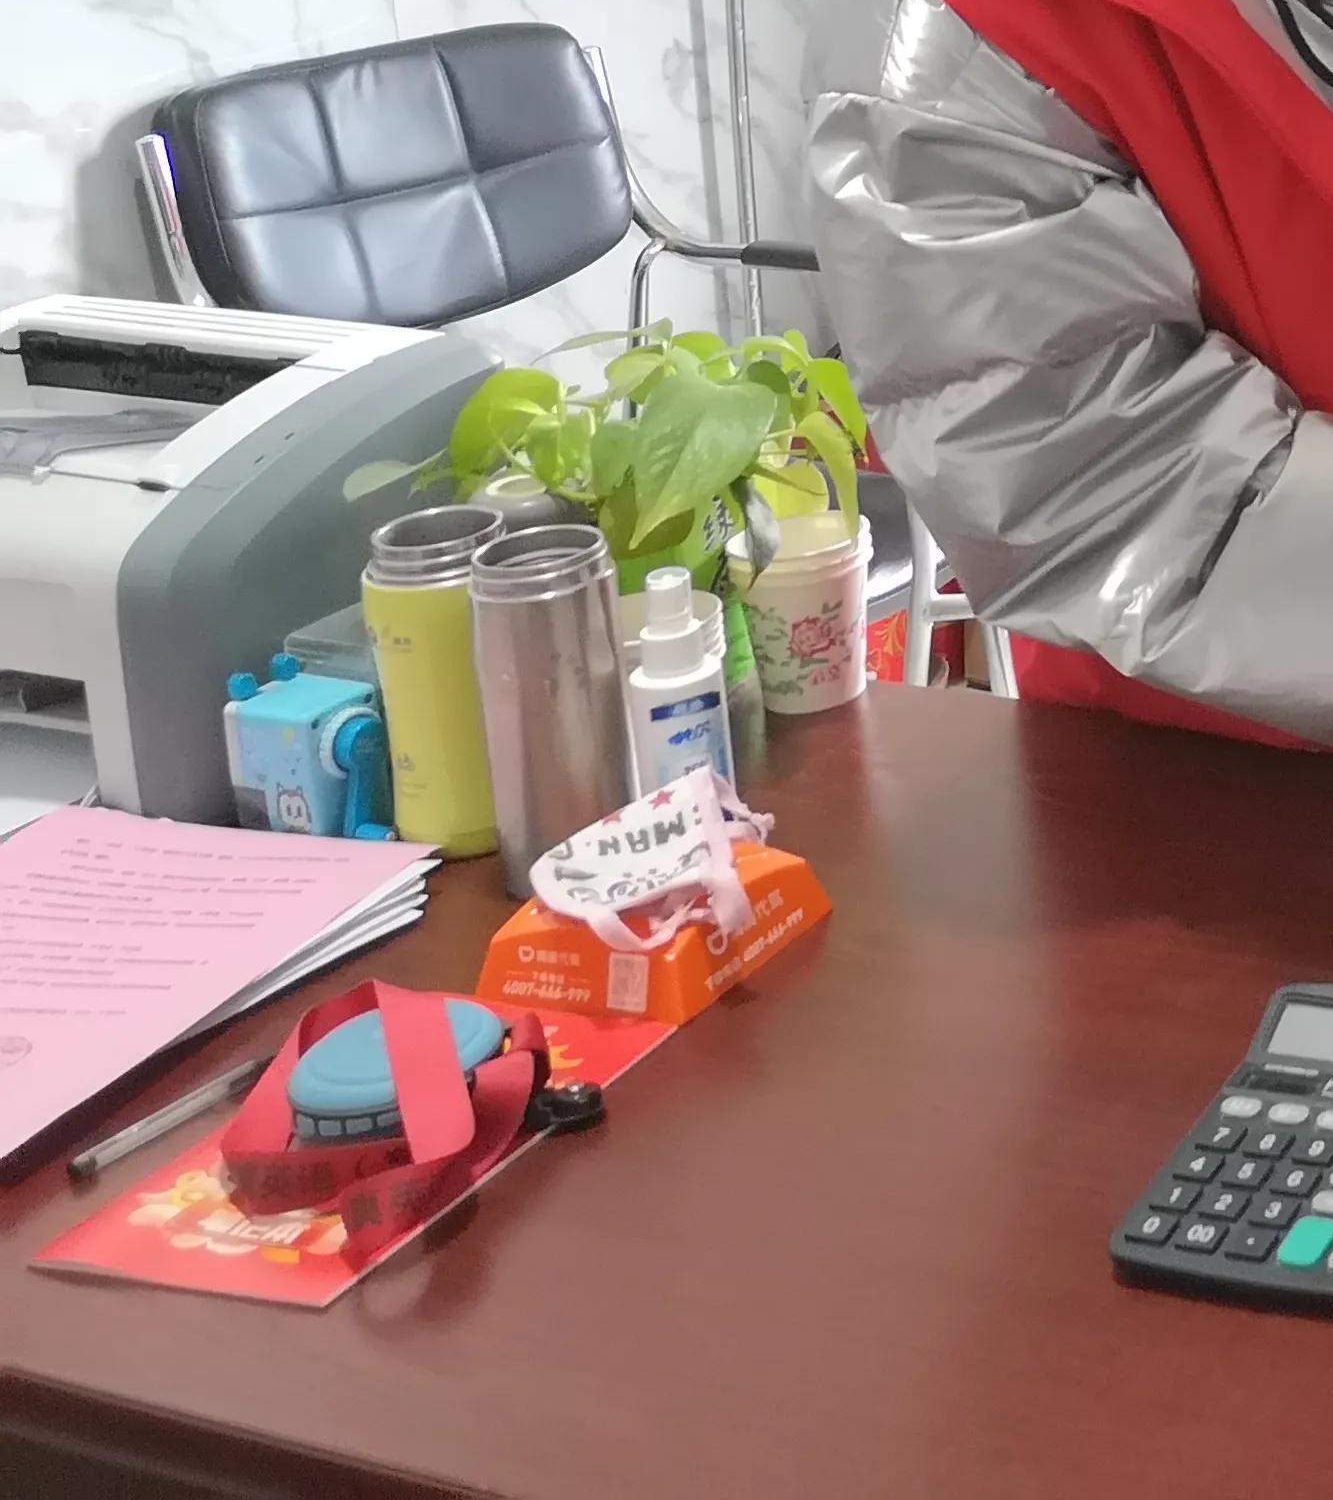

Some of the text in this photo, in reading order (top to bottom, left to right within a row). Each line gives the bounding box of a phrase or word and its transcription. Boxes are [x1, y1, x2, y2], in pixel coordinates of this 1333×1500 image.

[1214, 1126, 1232, 1143] 7
[1168, 1186, 1183, 1204] 1
[1141, 1215, 1161, 1234] 0
